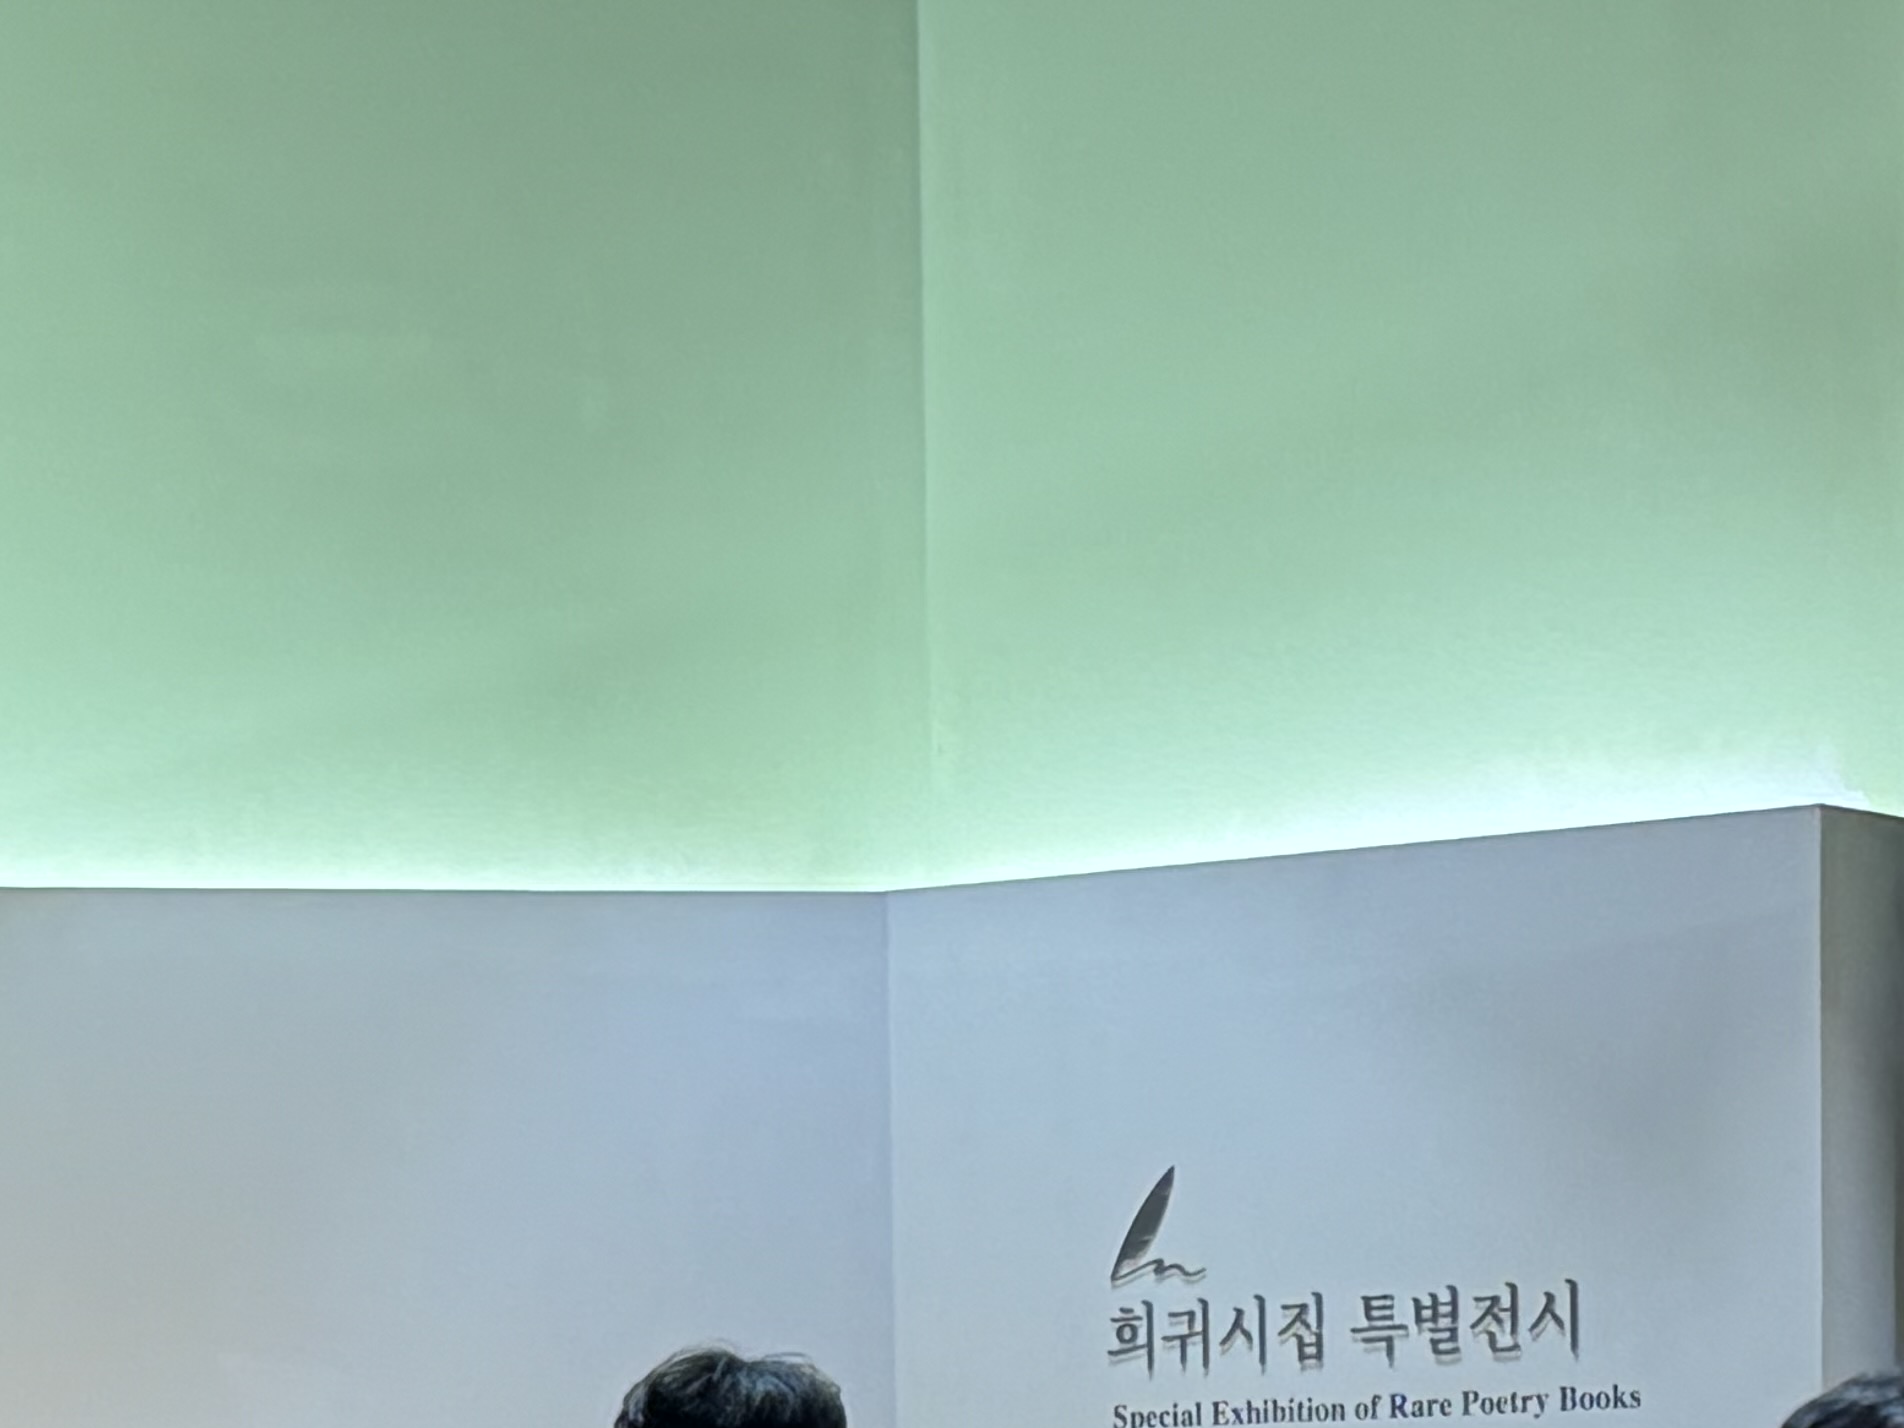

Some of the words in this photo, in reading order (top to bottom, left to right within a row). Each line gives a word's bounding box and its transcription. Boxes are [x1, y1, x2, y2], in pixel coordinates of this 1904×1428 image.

[1107, 1291, 1325, 1379] 희귀시집
[1350, 1278, 1580, 1369] 특별전시
[1212, 1396, 1346, 1427] Exhibition
[1354, 1394, 1382, 1421] of
[1389, 1392, 1452, 1419] Rare
[1462, 1388, 1550, 1420] Poetry
[1559, 1382, 1642, 1412] Books
